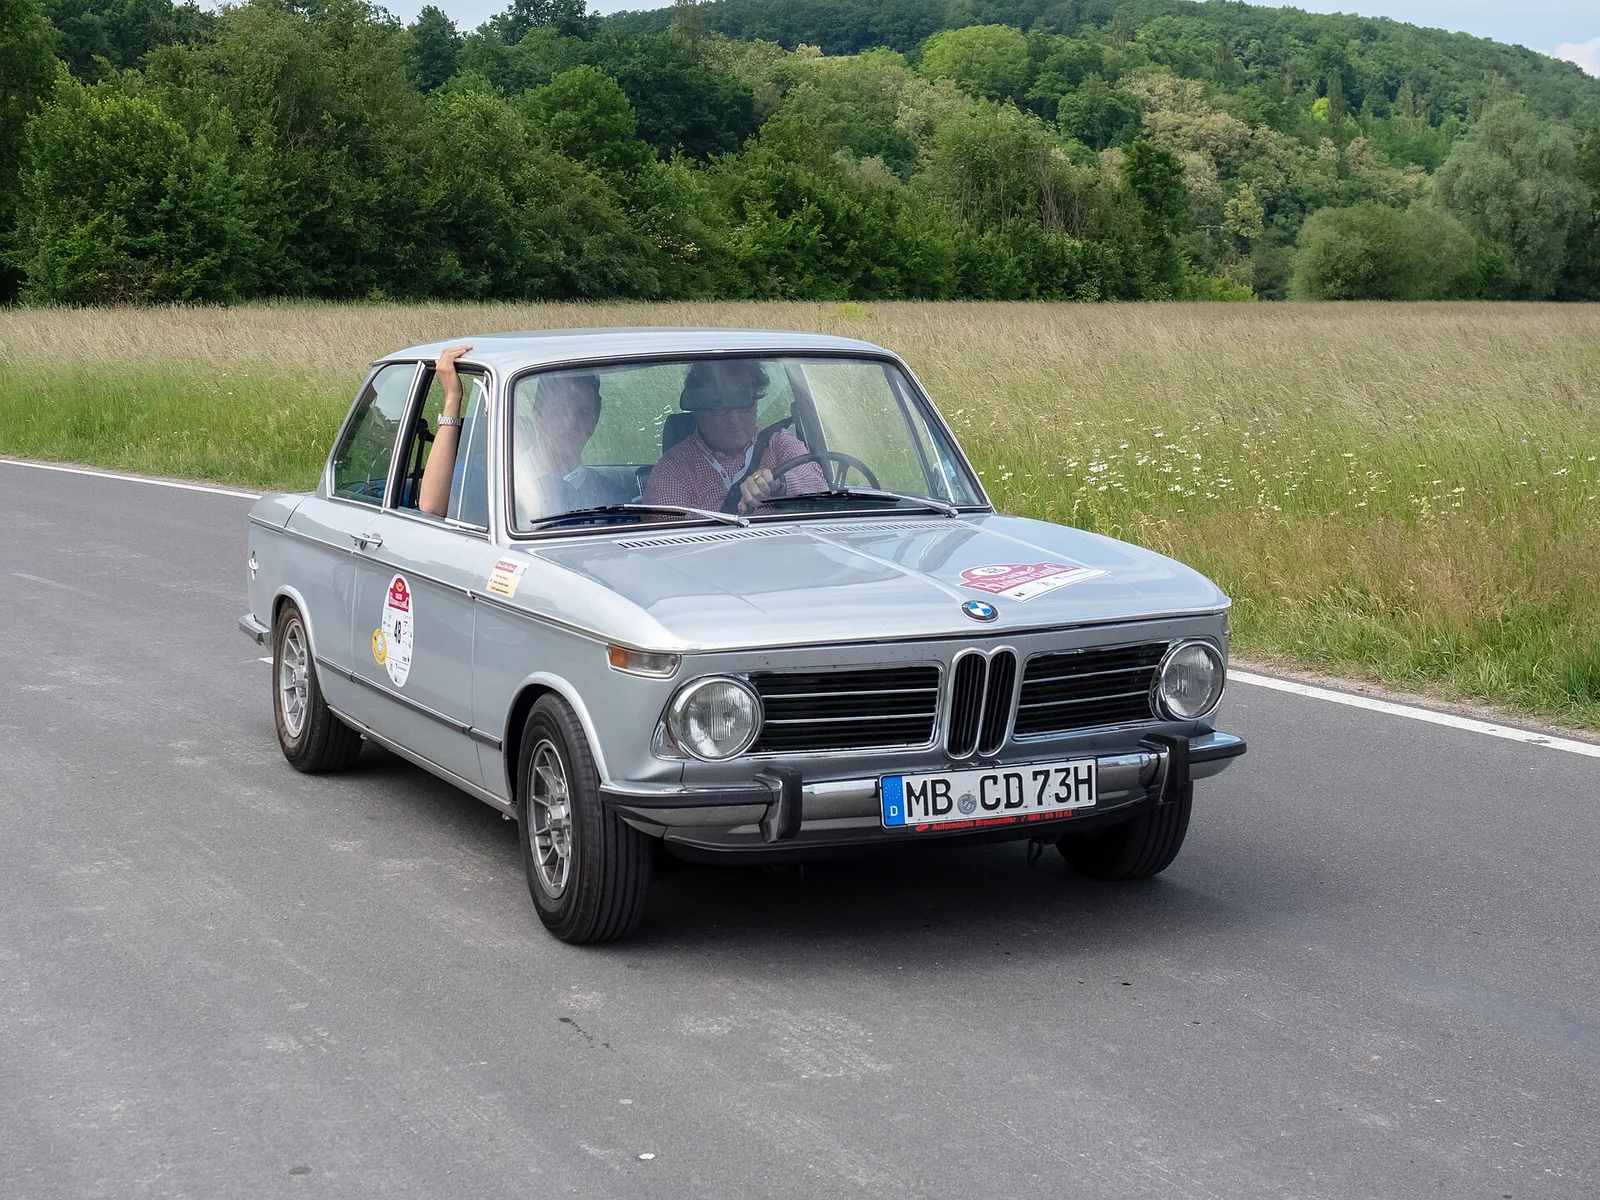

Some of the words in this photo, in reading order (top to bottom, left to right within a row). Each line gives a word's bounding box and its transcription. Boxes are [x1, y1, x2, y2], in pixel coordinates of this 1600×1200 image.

[394, 620, 402, 644] 48
[906, 779, 953, 817] MB
[979, 772, 1024, 810] CD
[1032, 765, 1093, 806] 73H
[889, 805, 898, 817] D
[932, 820, 974, 830] Automobile
